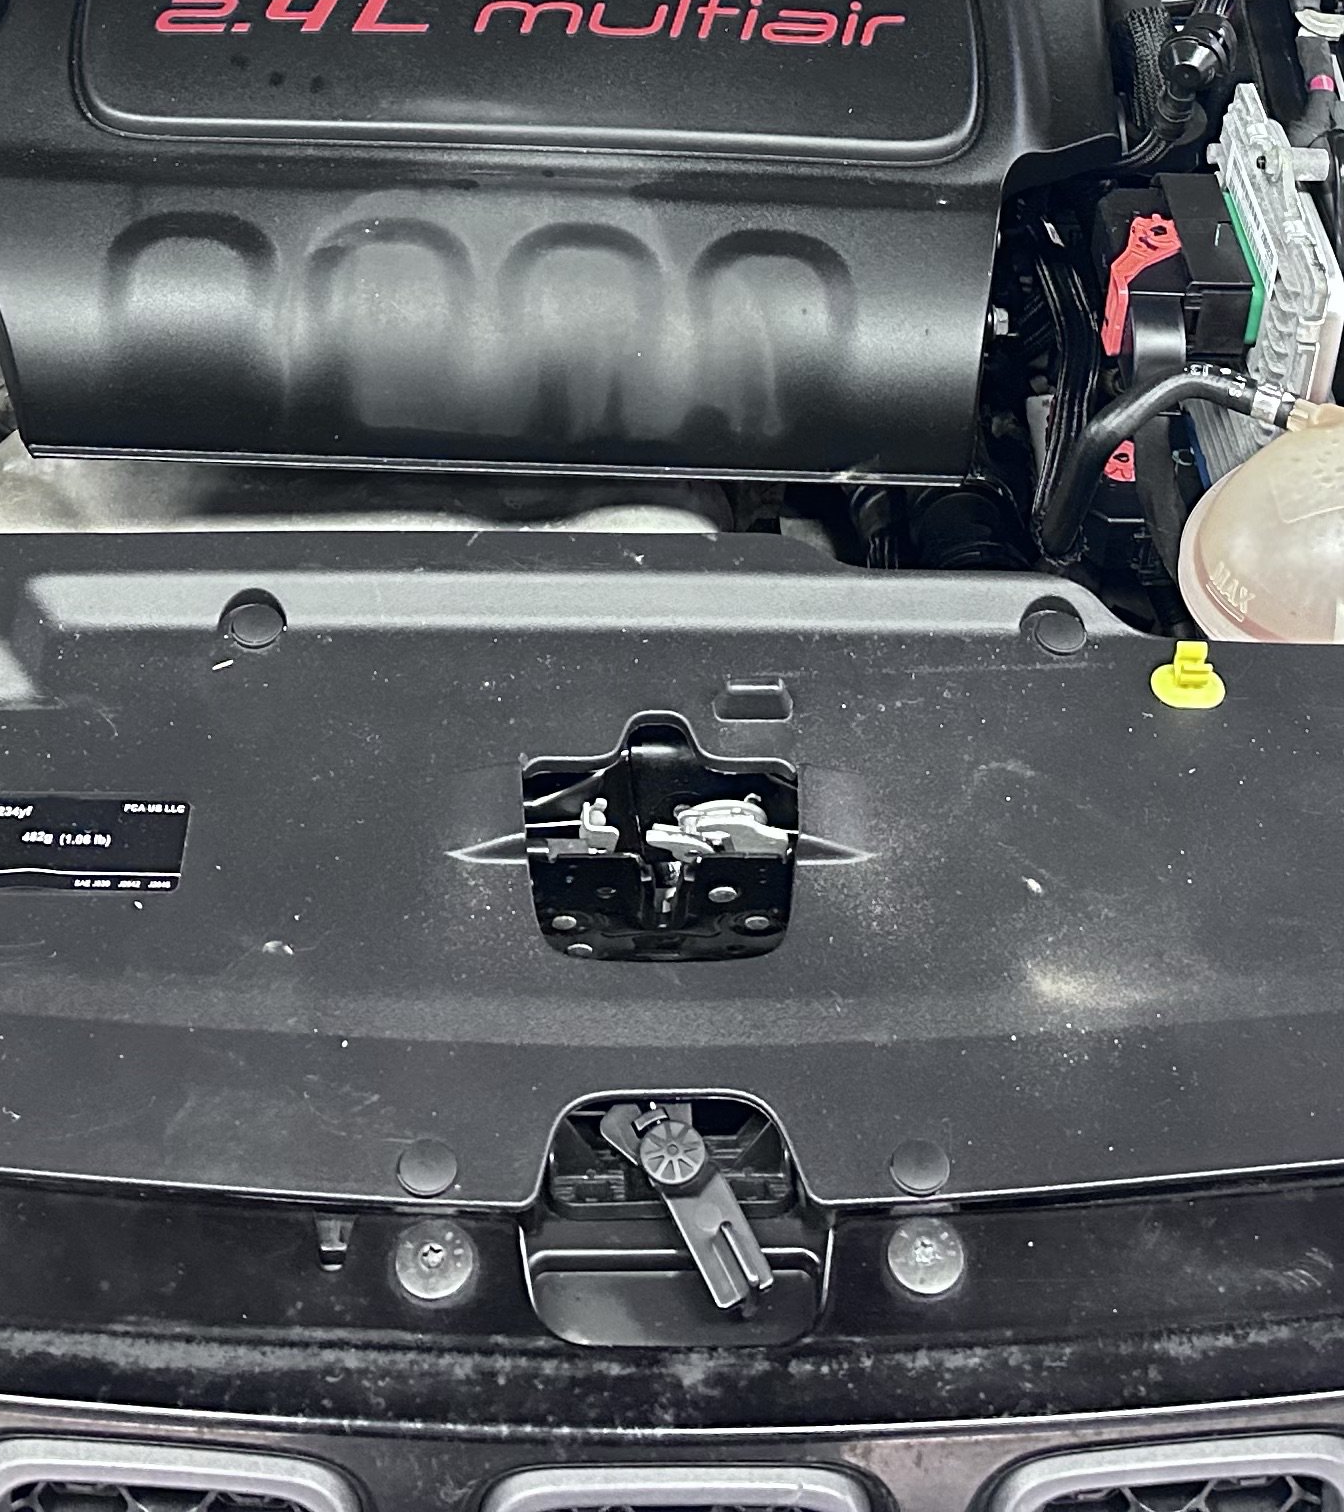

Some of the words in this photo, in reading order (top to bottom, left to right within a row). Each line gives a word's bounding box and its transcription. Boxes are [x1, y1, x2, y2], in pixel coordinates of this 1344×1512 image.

[1209, 560, 1257, 614] MAX
[123, 803, 146, 813] FCA
[164, 804, 186, 814] LLC
